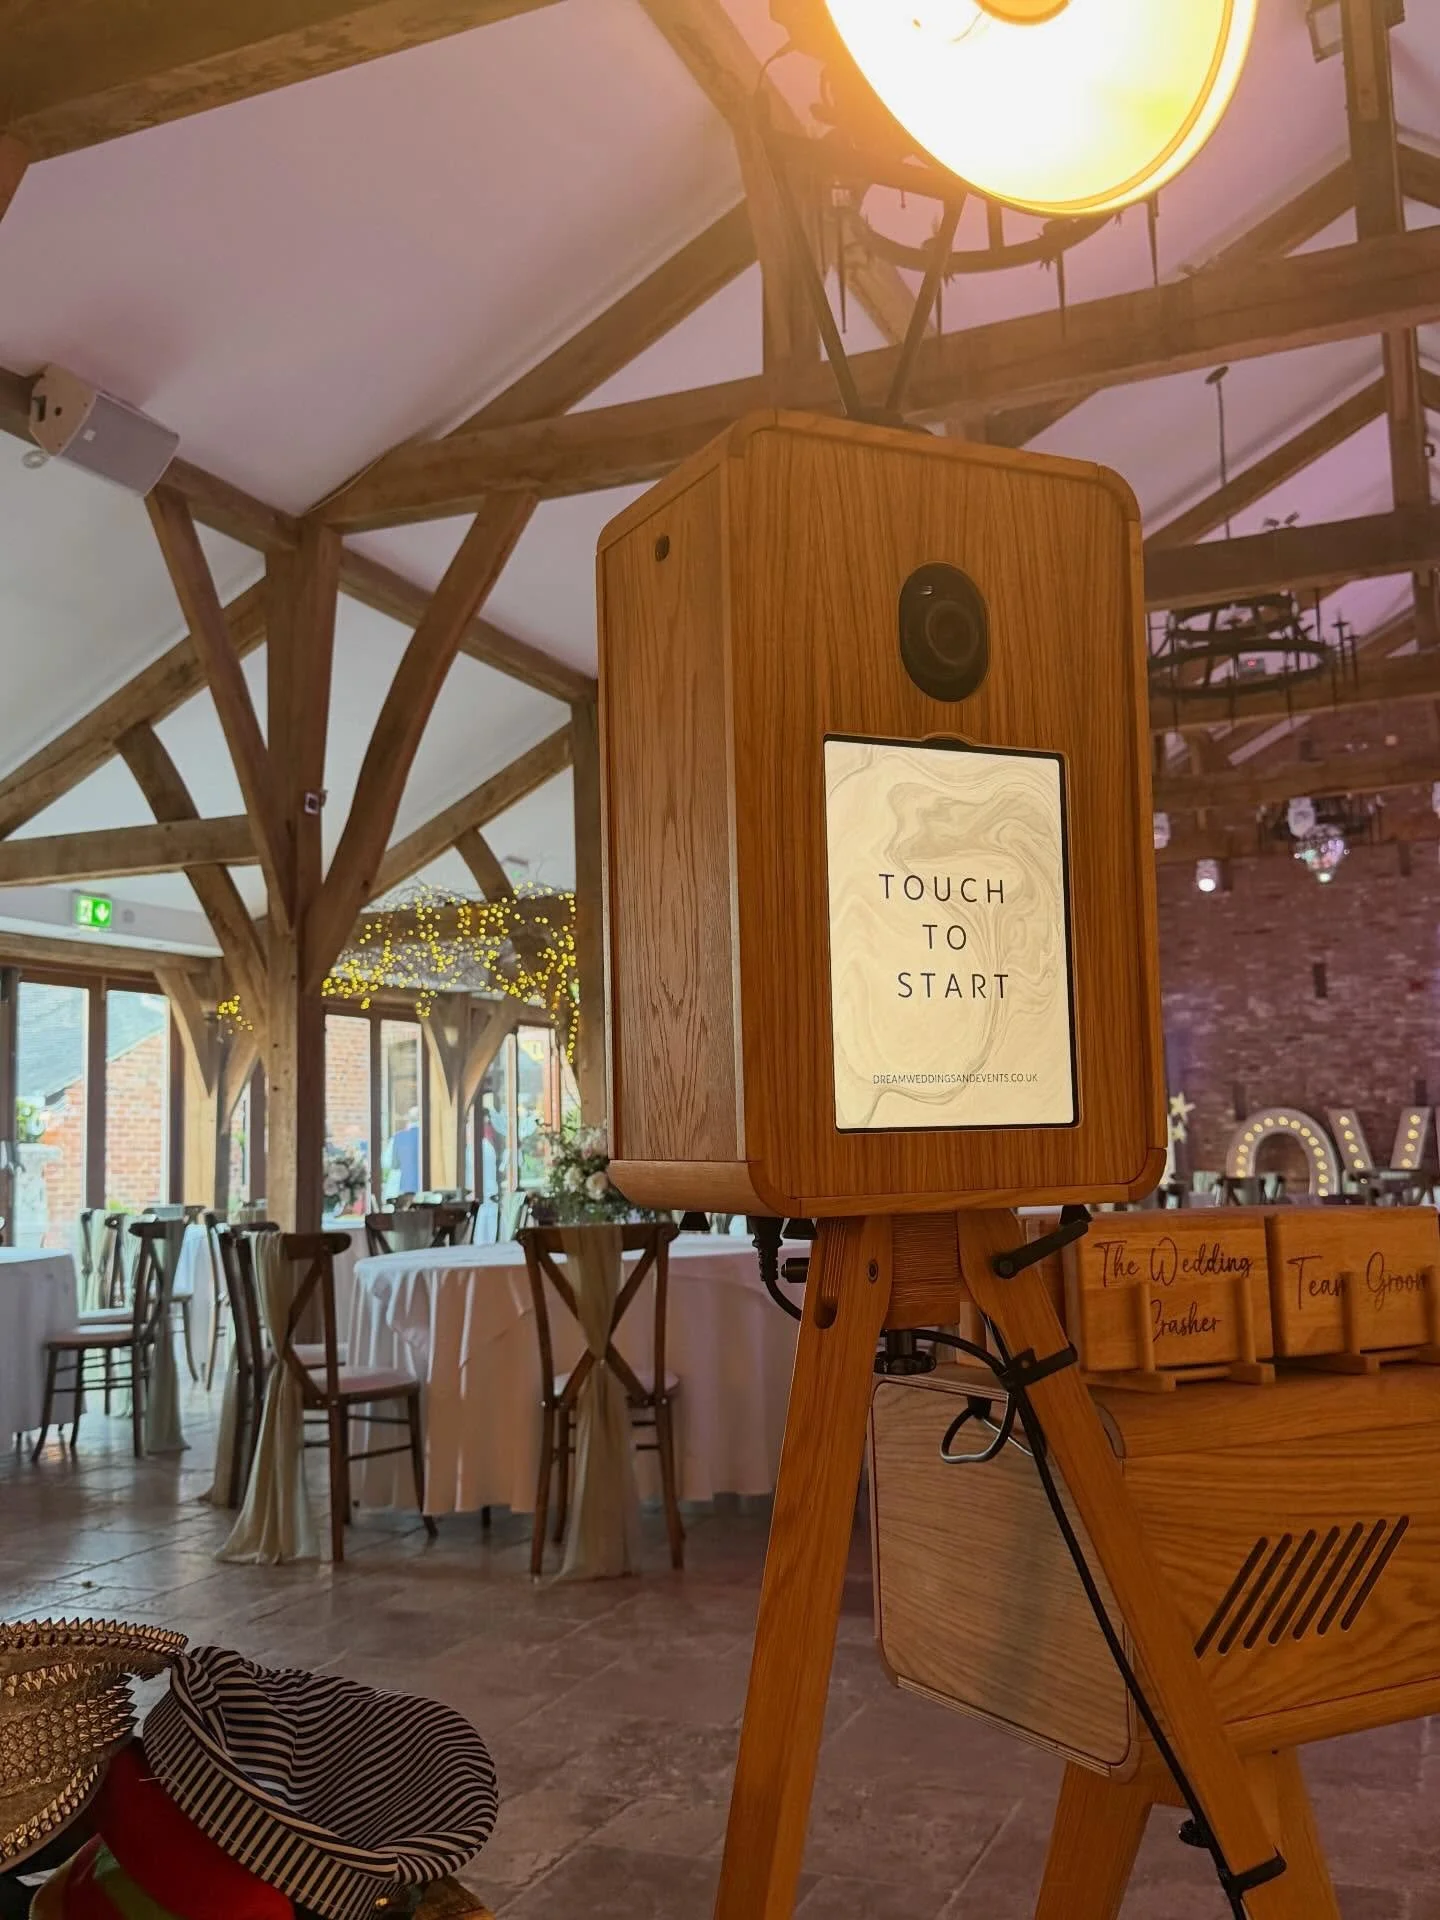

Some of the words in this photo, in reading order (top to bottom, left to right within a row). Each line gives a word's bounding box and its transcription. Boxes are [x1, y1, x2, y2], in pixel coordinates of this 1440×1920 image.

[878, 873, 1004, 904] TOUCH
[922, 924, 967, 950] TO
[897, 972, 1009, 999] START
[873, 1073, 1038, 1084] DREAMWEDDINGSANDEVENTS.CO.UK
[1093, 1240, 1141, 1288] The
[1150, 1237, 1254, 1286] Wedding
